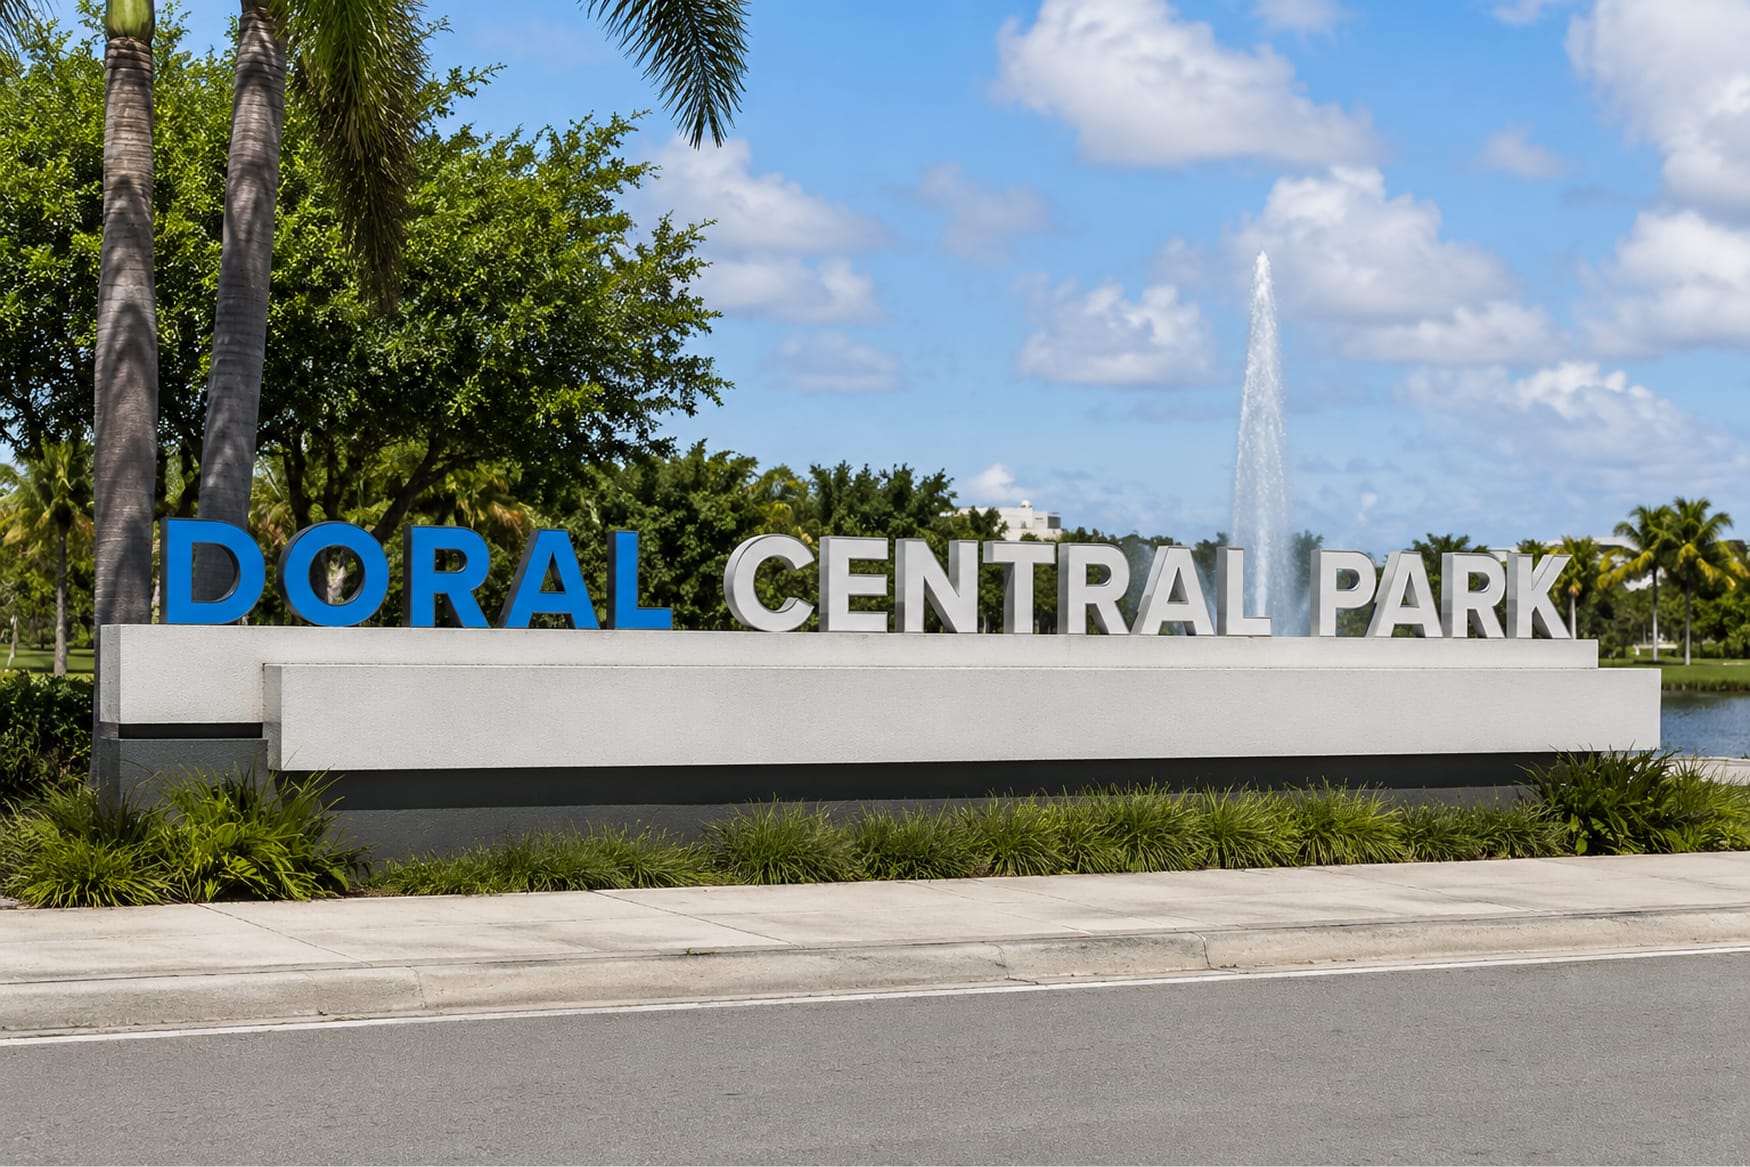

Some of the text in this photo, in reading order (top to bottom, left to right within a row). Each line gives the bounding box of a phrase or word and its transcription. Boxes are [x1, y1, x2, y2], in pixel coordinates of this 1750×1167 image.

[160, 517, 1573, 639] DORAL CENTRAL PARK
